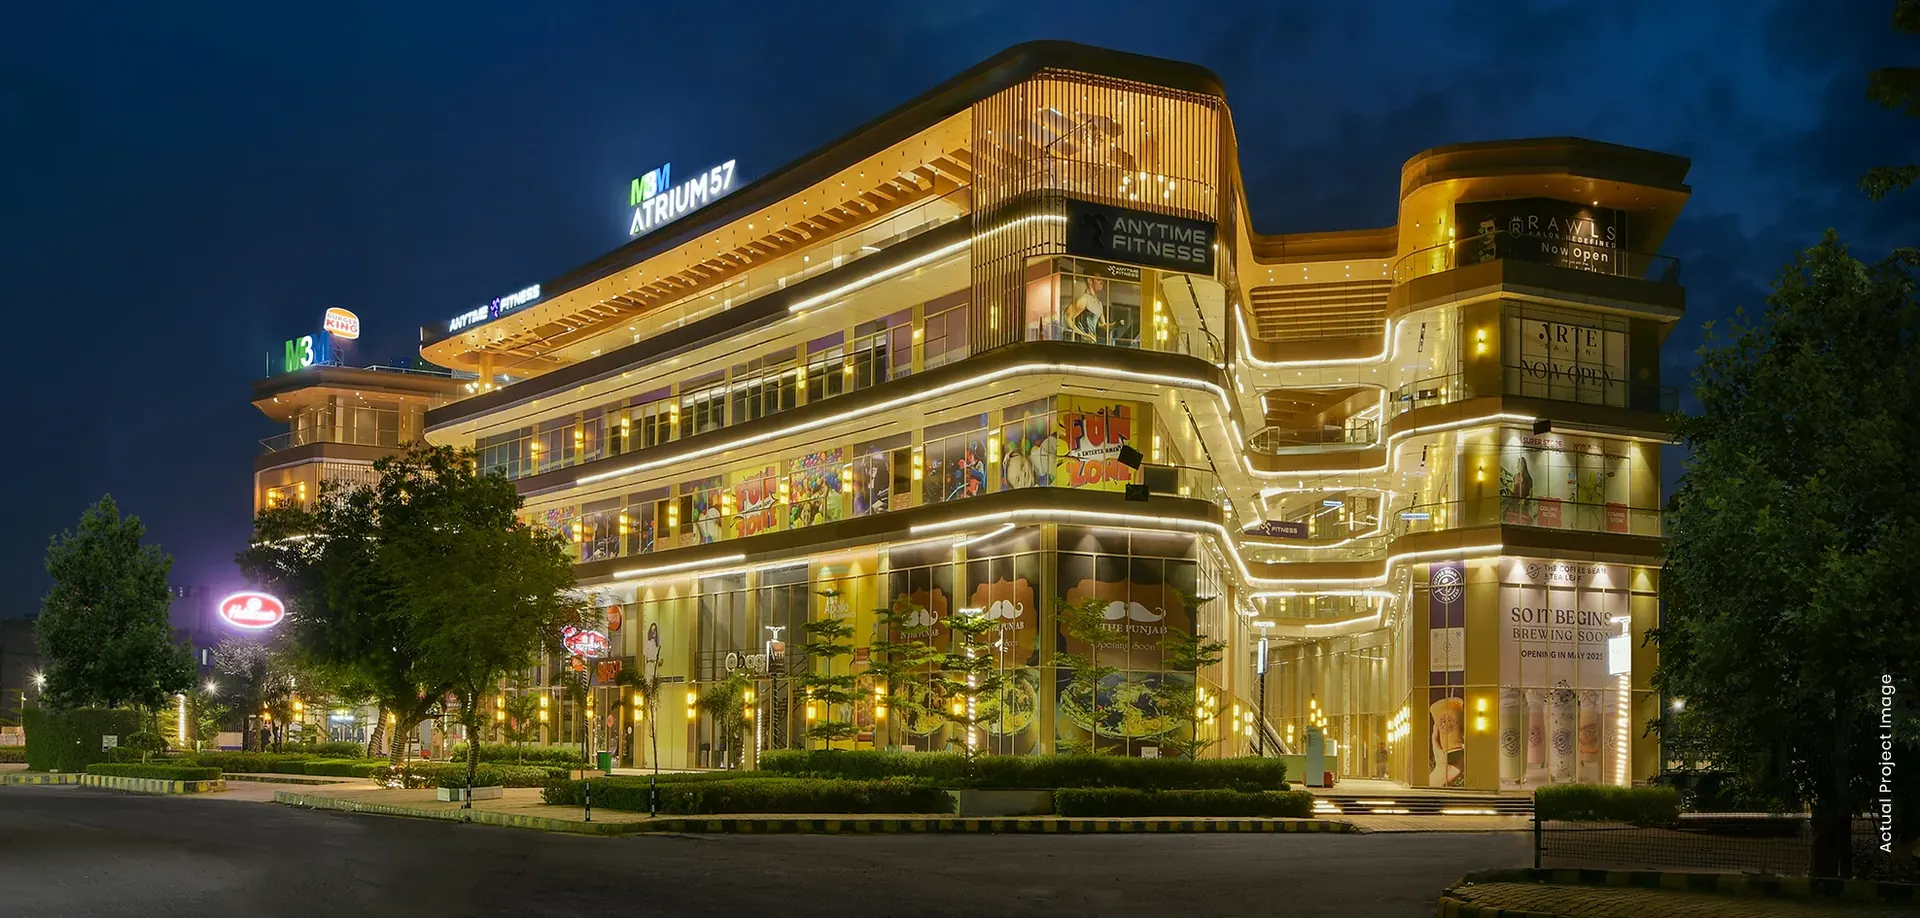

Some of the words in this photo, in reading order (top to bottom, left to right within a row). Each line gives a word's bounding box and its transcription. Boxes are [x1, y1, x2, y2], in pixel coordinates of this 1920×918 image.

[630, 162, 671, 206] M3M
[629, 172, 708, 235] ATRIUM
[709, 159, 736, 195] 57
[1113, 216, 1206, 246] ANYTIME
[1528, 215, 1617, 241] RAWLS
[1112, 234, 1206, 263] FITNESS
[1541, 242, 1569, 256] Now
[1573, 247, 1608, 263] Open
[1114, 271, 1140, 279] FITNESS
[1115, 266, 1140, 275] ANYTIME
[500, 283, 541, 312] FITNESS
[326, 319, 358, 333] KING
[327, 313, 358, 325] BURGER
[448, 304, 489, 333] ANYTIME
[285, 330, 331, 372] M3M
[1521, 359, 1563, 381] NOW
[1567, 365, 1614, 389] OPEN
[1063, 405, 1132, 451] FUN
[1271, 526, 1298, 534] FITNESS
[1544, 564, 1557, 572] THE
[1511, 607, 1533, 623] SO
[1537, 608, 1552, 623] IT
[1556, 609, 1613, 627] BEGINS
[1126, 625, 1168, 636] PUNJAB
[1512, 627, 1573, 641] BREWING
[1578, 631, 1613, 642] SOON
[1132, 641, 1156, 651] Soon
[1521, 649, 1556, 659] OPENING
[1558, 651, 1566, 659] IN
